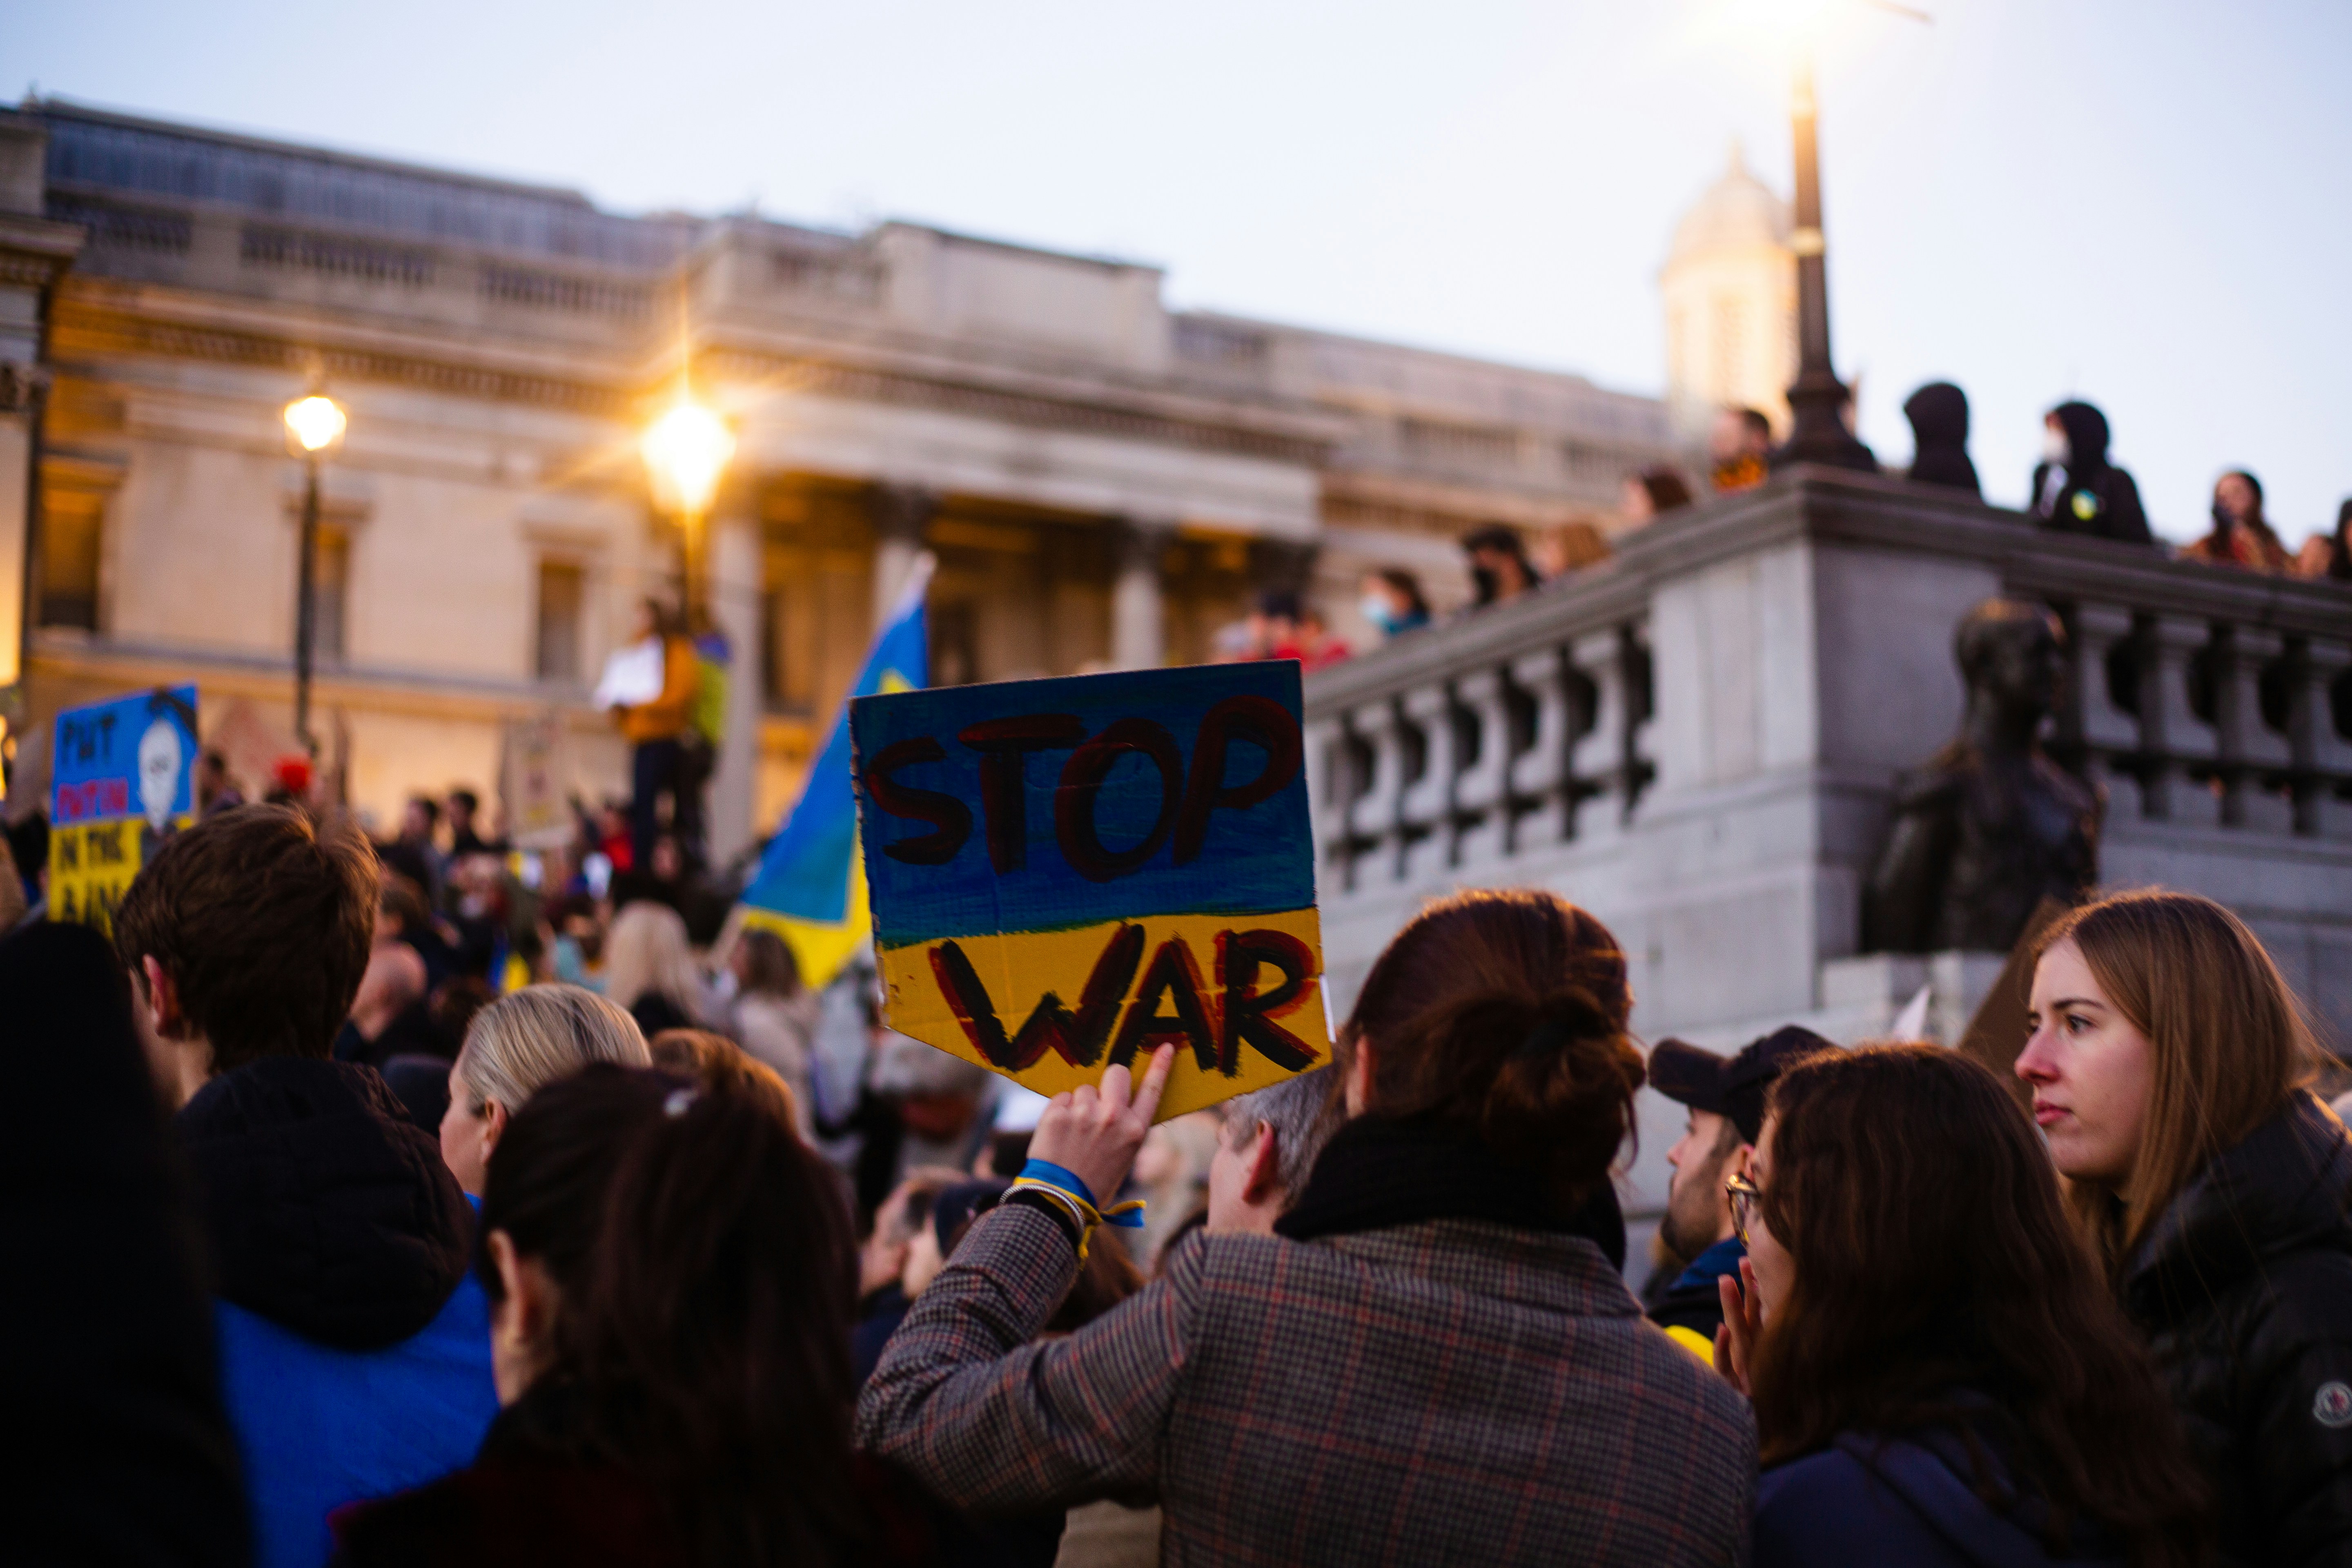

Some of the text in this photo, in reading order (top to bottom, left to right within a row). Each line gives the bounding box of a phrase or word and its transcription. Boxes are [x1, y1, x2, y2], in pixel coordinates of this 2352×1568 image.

[60, 713, 116, 768] PUT
[866, 695, 1301, 882] STOP
[929, 920, 1321, 1077] WAR
